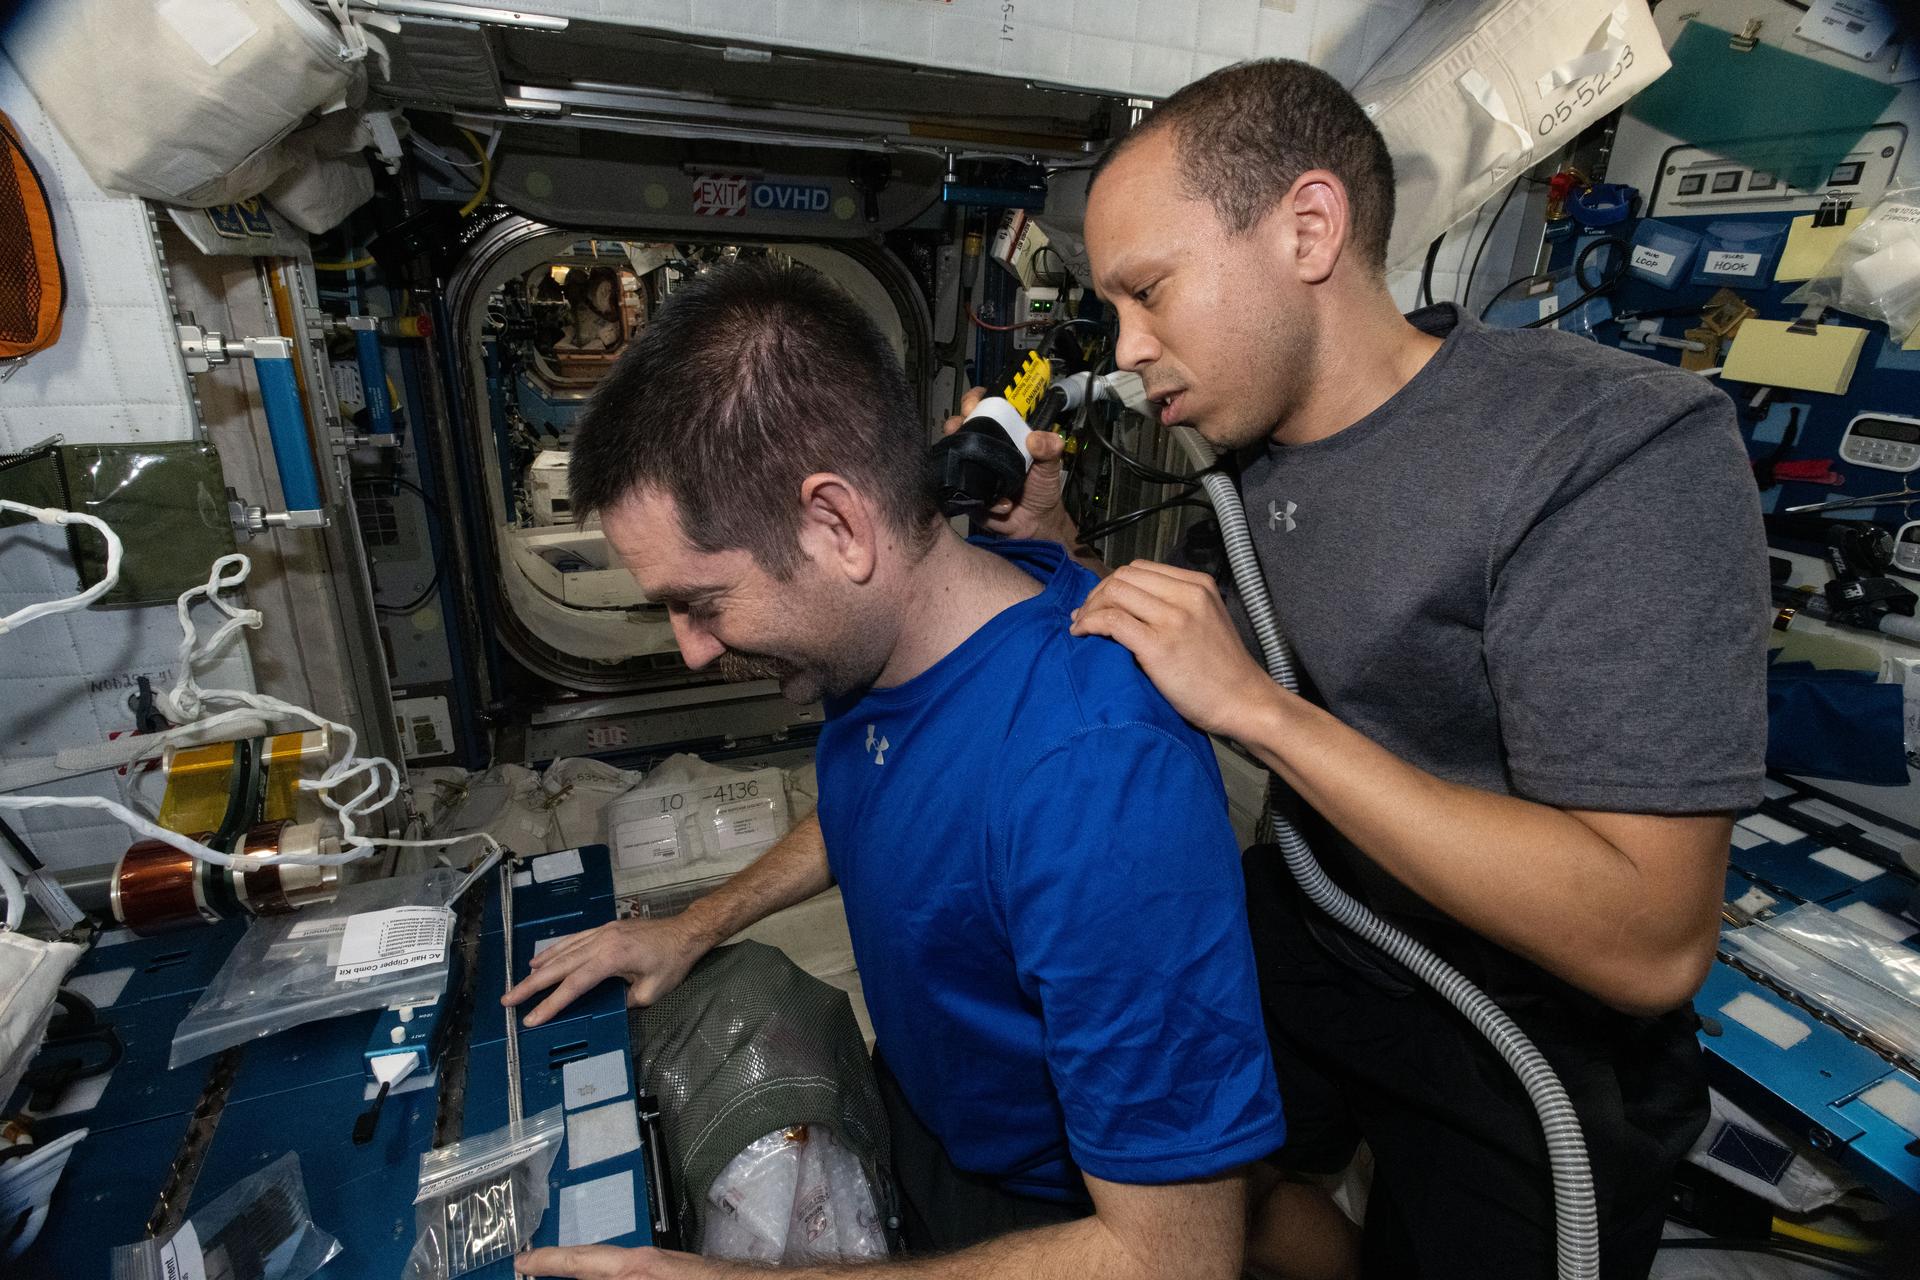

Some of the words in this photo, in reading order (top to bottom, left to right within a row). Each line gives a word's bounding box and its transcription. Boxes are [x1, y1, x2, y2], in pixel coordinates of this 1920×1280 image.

[999, 0, 1016, 42] 5-41
[701, 182, 738, 206] EXIT
[754, 184, 830, 210] OVHD
[1635, 256, 1659, 268] LOOP
[1713, 260, 1749, 272] HOOK
[1025, 376, 1046, 404] WARNING
[380, 959, 409, 969] Clipper
[410, 954, 427, 962] Hair
[353, 965, 378, 973] Comb
[444, 1170, 474, 1184] Comb
